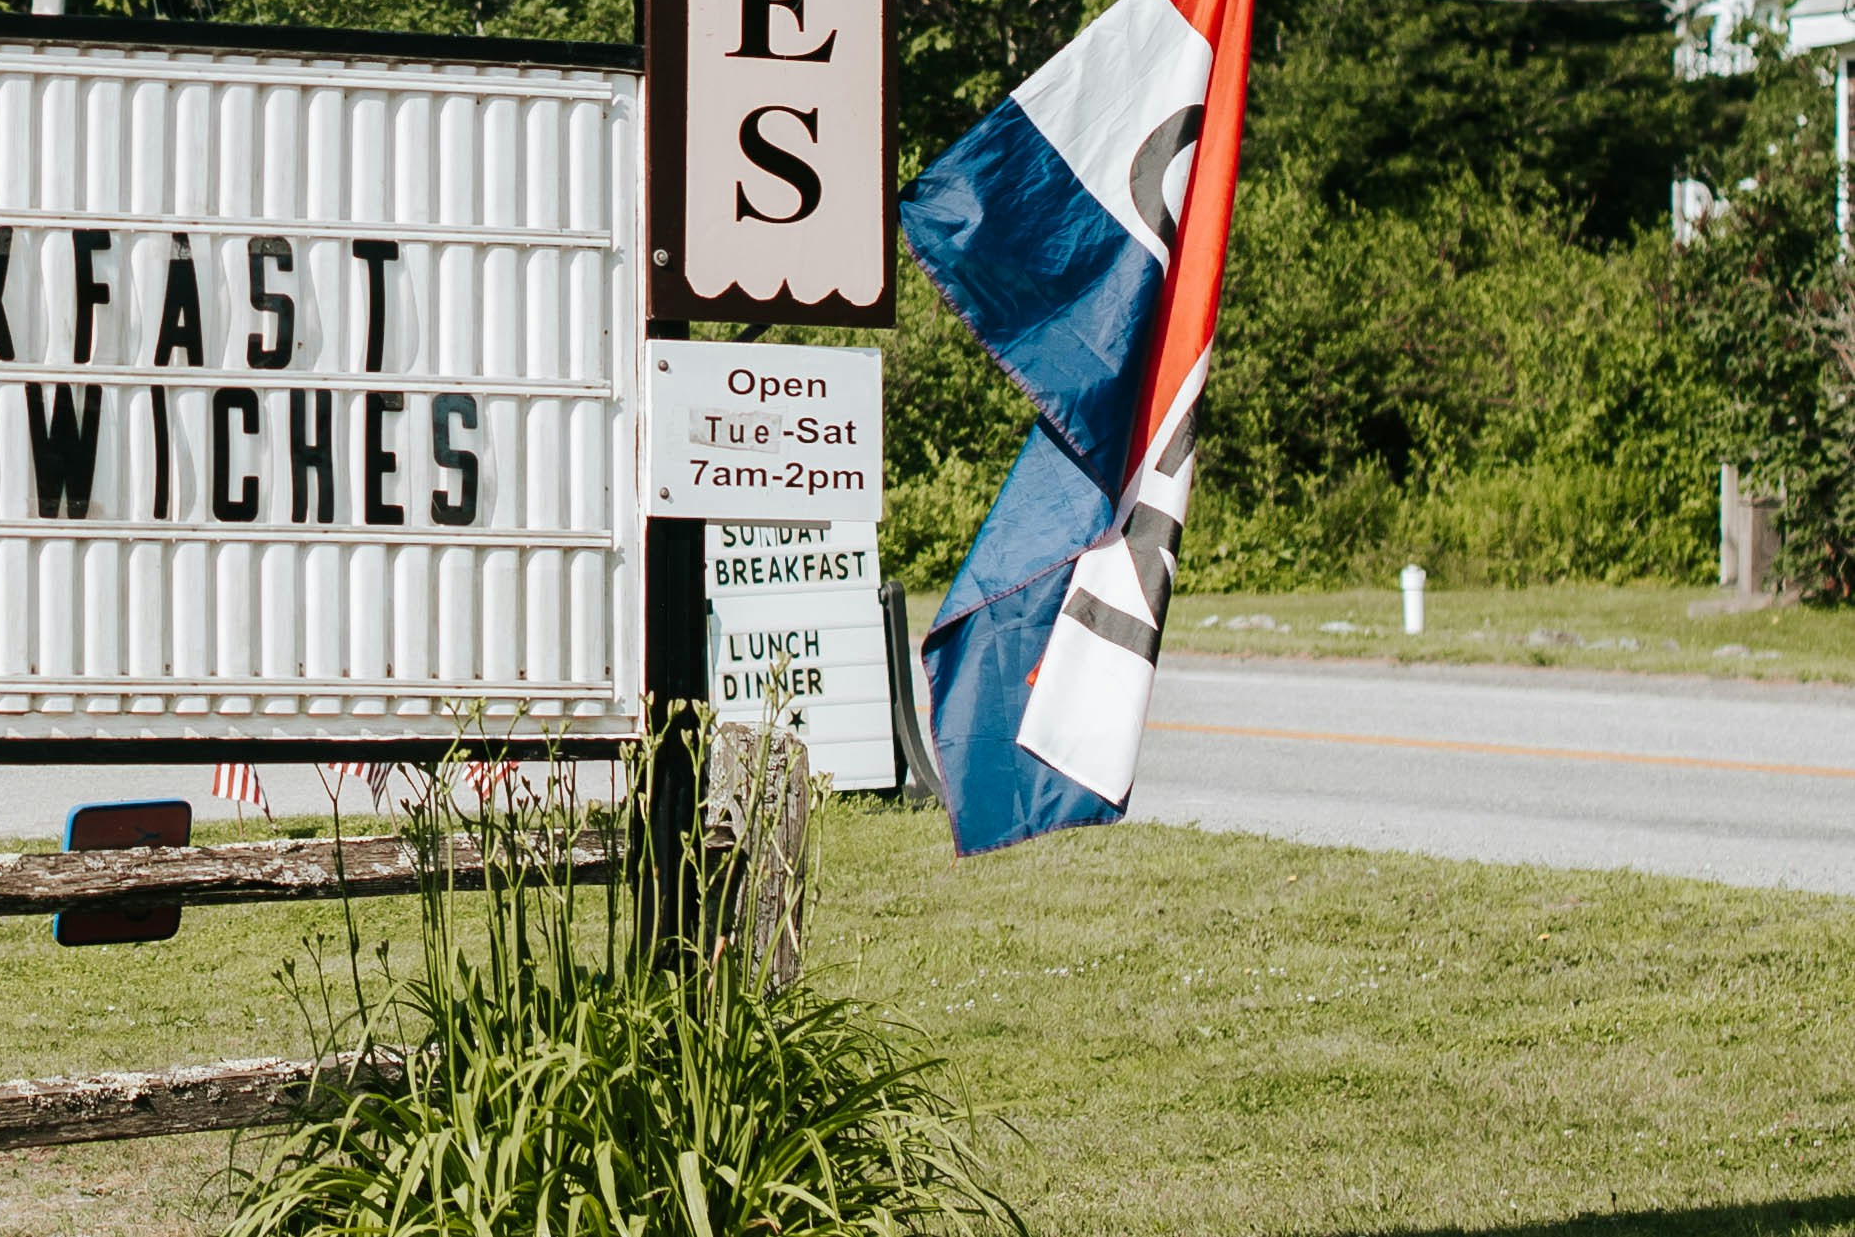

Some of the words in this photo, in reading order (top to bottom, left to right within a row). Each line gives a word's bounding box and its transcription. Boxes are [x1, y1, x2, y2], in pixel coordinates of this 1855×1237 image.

[728, 369, 827, 403] Open
[690, 459, 864, 496] 7am-2pm
[715, 551, 866, 586] BREAKFAST
[730, 630, 820, 662] LUNCH
[724, 667, 823, 701] DINNER
